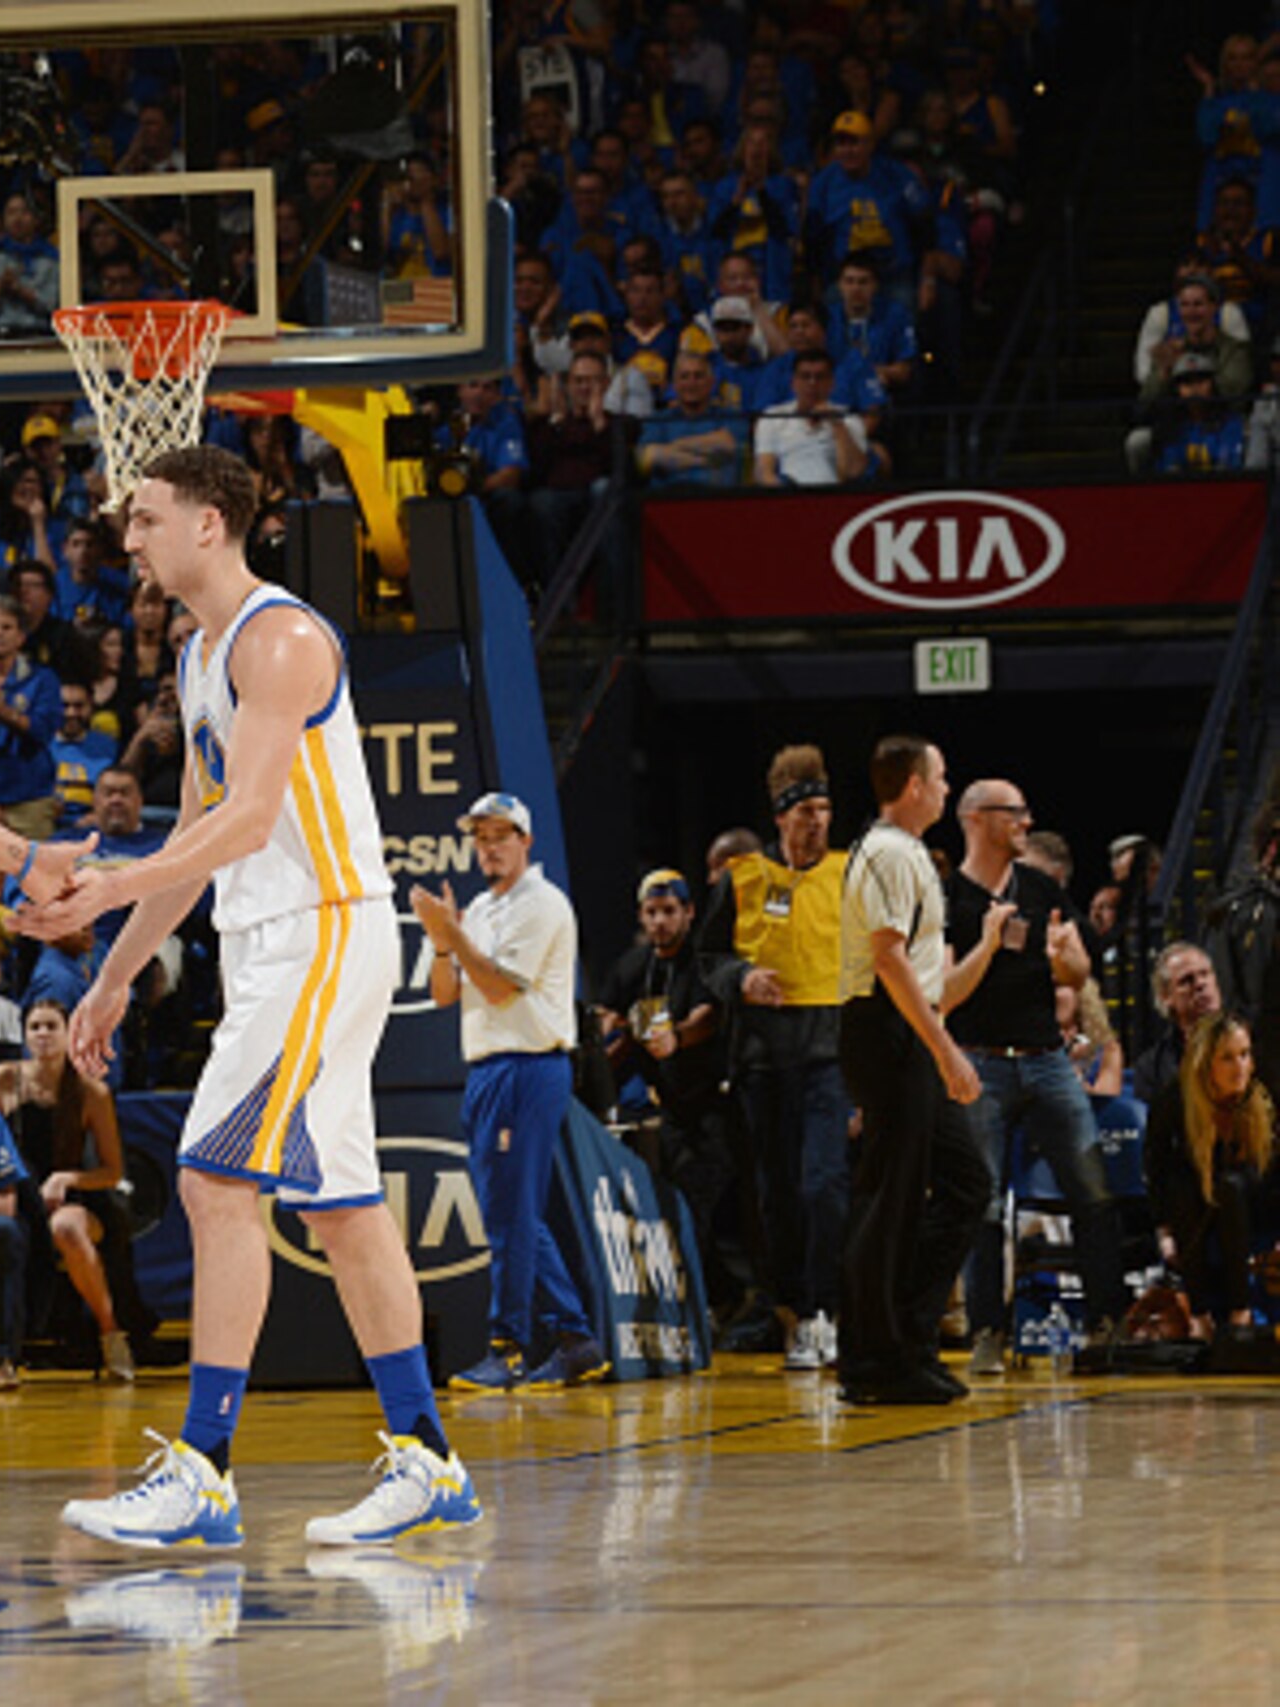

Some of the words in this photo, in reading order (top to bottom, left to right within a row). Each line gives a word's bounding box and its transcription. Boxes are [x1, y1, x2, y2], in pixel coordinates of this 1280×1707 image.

[874, 516, 1027, 583] KIA
[929, 646, 979, 685] EXIT
[358, 721, 461, 795] TE
[383, 834, 473, 877] CSN
